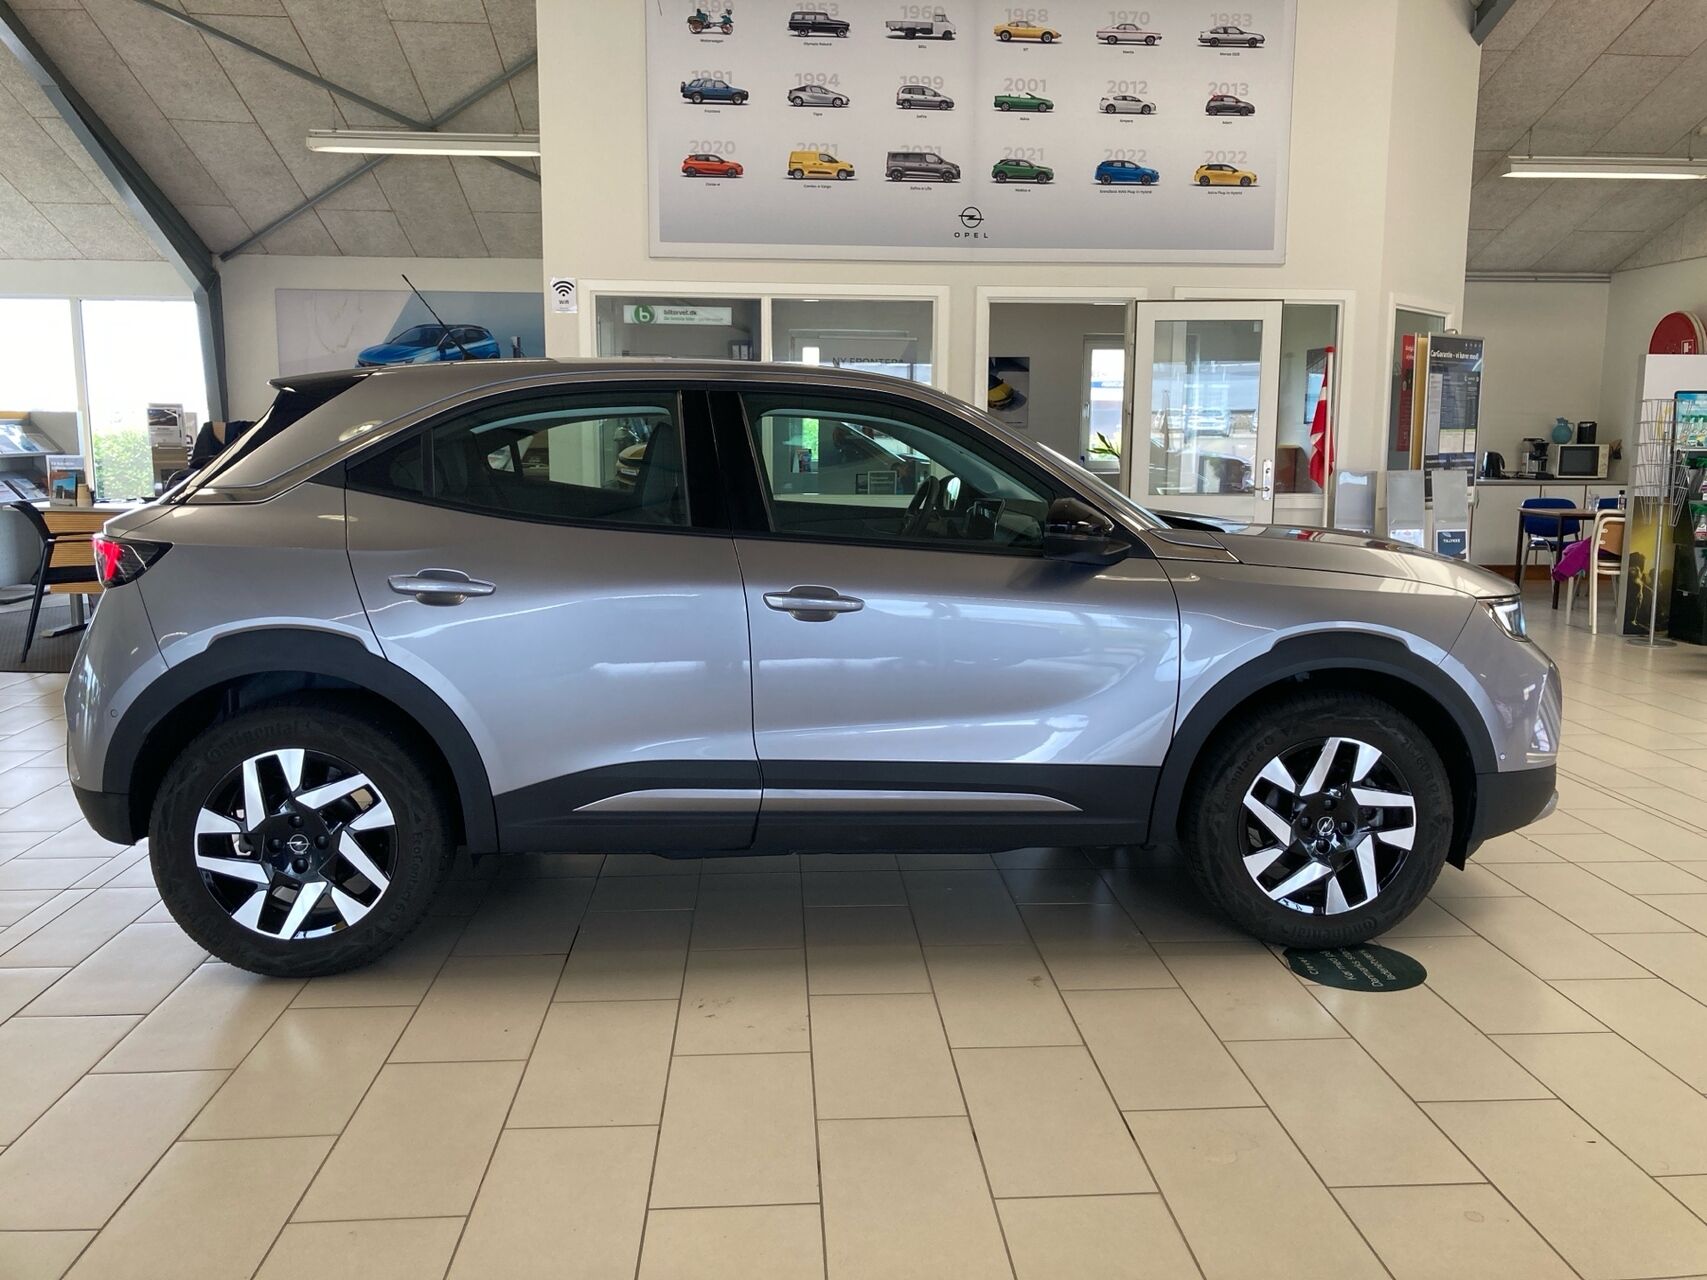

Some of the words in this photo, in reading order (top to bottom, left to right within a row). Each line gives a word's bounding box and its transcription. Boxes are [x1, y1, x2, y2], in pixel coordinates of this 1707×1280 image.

[1004, 8, 1049, 23] 1968
[1109, 11, 1151, 25] 1970
[1211, 13, 1252, 27] 1983
[795, 72, 840, 87] 1994
[1004, 78, 1047, 93] 2001
[1107, 80, 1148, 95] 2012
[1209, 82, 1249, 97] 2013
[689, 140, 736, 155] 2020
[1004, 147, 1044, 161] 2021
[1104, 149, 1147, 163] 2022
[1206, 150, 1248, 165] 2022
